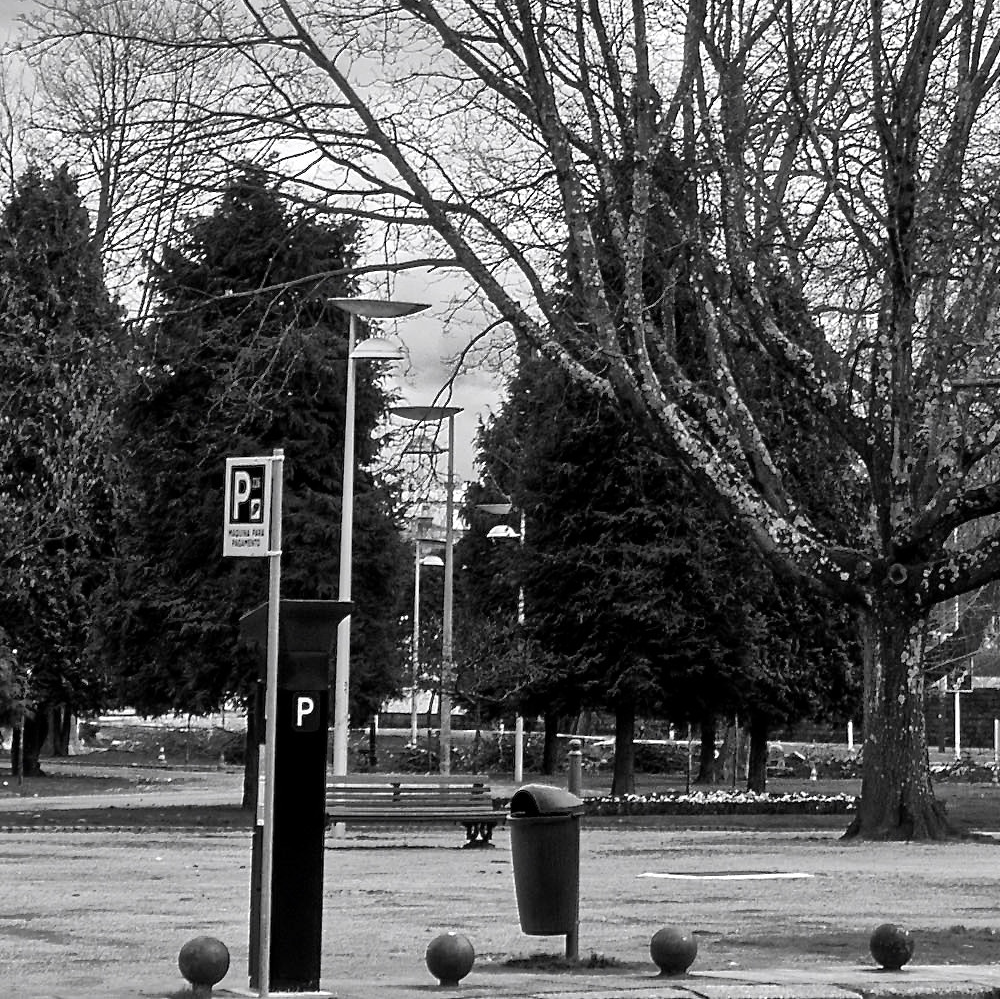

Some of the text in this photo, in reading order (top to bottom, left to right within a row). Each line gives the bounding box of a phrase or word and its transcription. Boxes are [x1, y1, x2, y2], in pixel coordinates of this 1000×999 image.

[234, 471, 250, 519] P
[231, 538, 260, 547] PAGAMENTO
[252, 529, 264, 537] PARA
[297, 697, 314, 726] P
